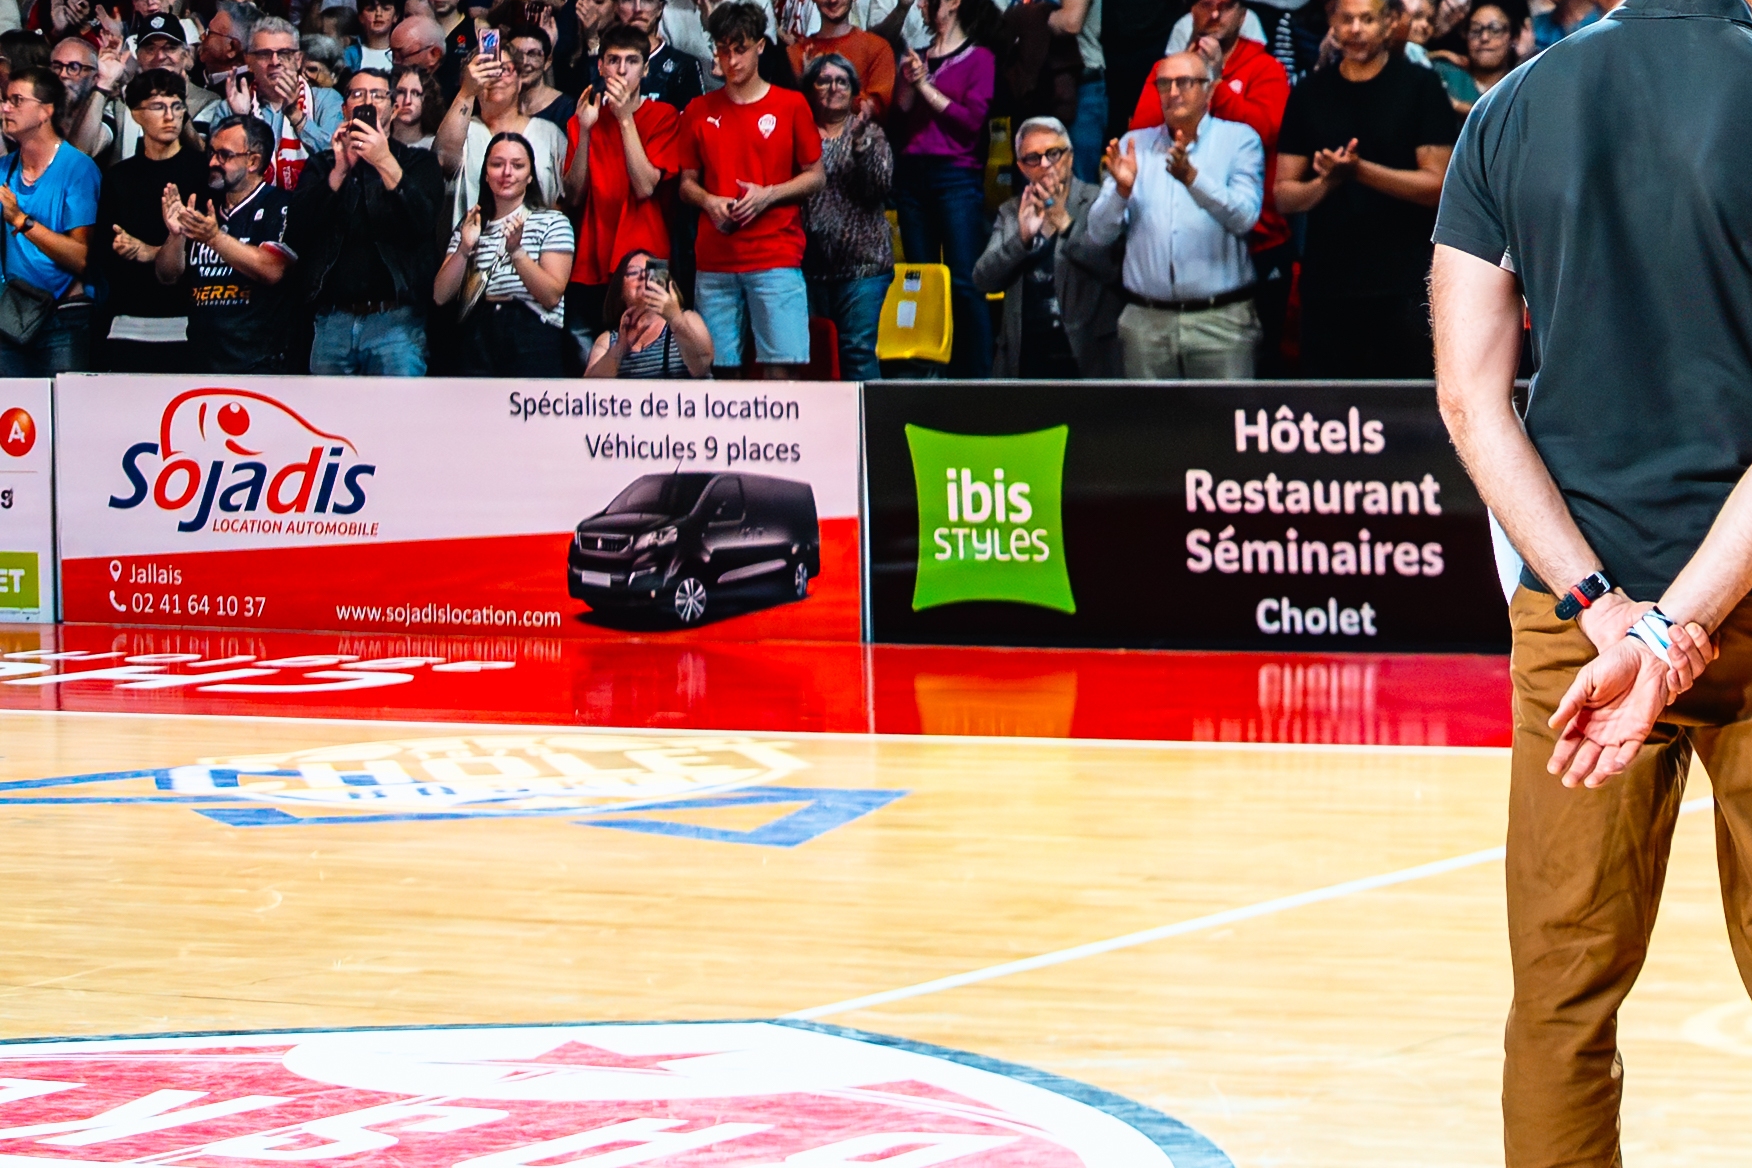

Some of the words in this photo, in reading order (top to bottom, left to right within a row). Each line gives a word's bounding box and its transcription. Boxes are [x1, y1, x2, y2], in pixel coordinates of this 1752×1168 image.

[508, 390, 633, 422] Spécialiste
[640, 392, 669, 418] de
[677, 392, 697, 418] la
[705, 393, 800, 420] location
[1234, 405, 1386, 455] Hôtels
[585, 433, 698, 460] Véhicules
[703, 436, 718, 461] 9
[726, 435, 801, 466] places
[108, 442, 376, 533] Sojadis
[946, 468, 1032, 523] ibis
[1185, 469, 1443, 516] Restaurant
[212, 518, 283, 535] LOCATION
[286, 520, 380, 537] AUTOMOBILE
[1185, 526, 1445, 577] Séminaires
[128, 563, 183, 586] Jallais
[131, 593, 154, 614] 02
[159, 594, 182, 615] 41
[187, 594, 210, 615] 64
[216, 595, 239, 616] 10
[244, 596, 267, 618] 37
[335, 603, 561, 629] www.sojadislocation.com
[1256, 597, 1377, 636] Cholet
